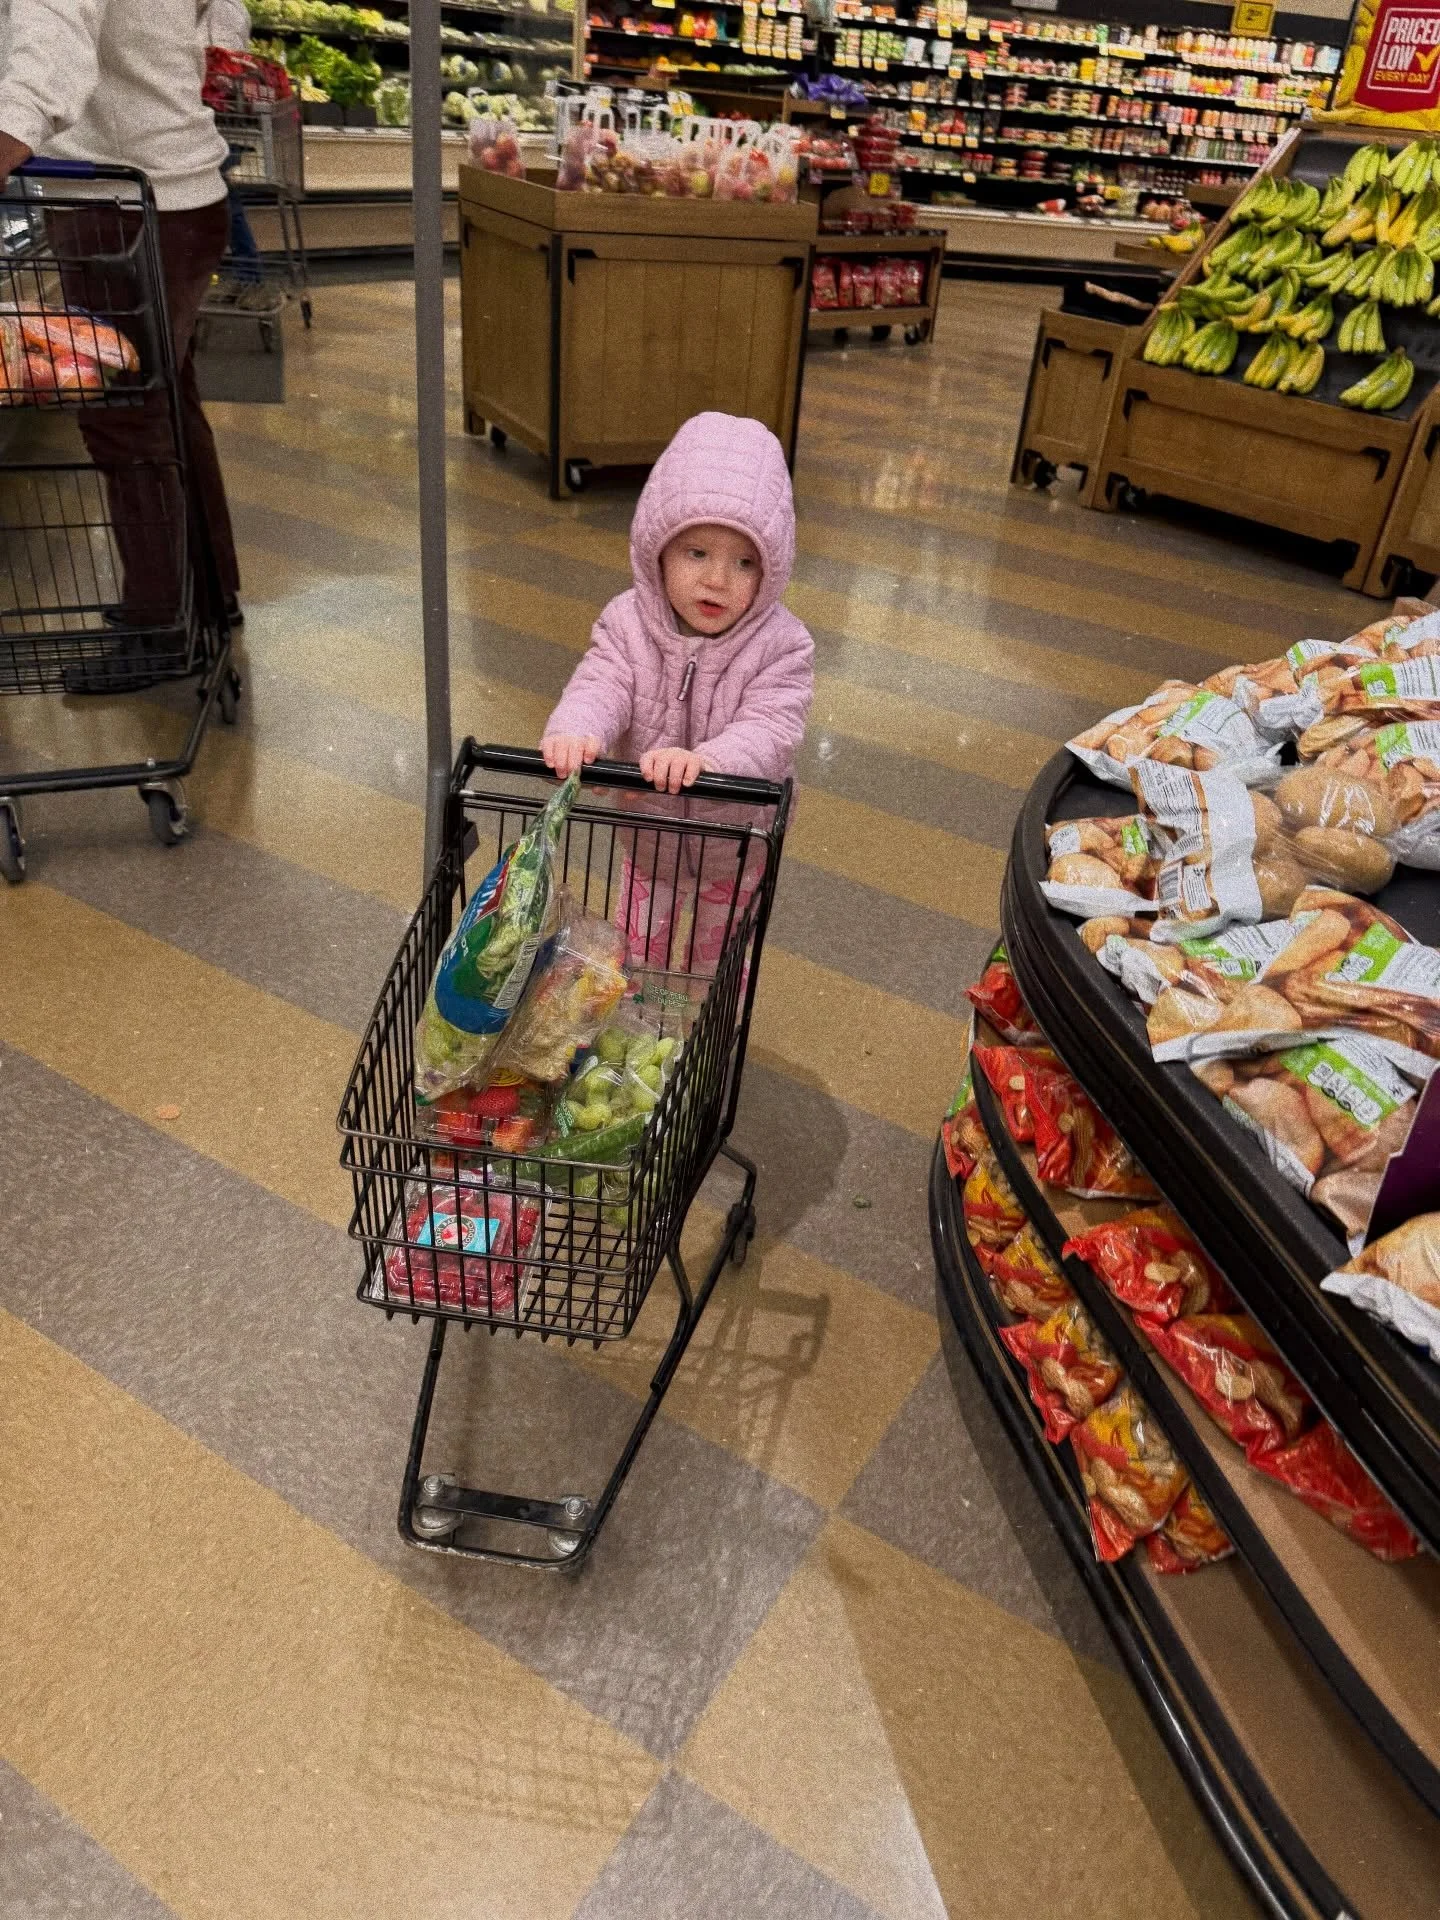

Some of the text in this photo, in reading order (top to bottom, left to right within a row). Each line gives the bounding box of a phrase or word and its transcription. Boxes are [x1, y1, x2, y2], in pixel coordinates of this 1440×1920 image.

[1385, 17, 1440, 45] PRICED
[1377, 44, 1417, 71] LOW
[1374, 70, 1430, 84] EVERY DAY
